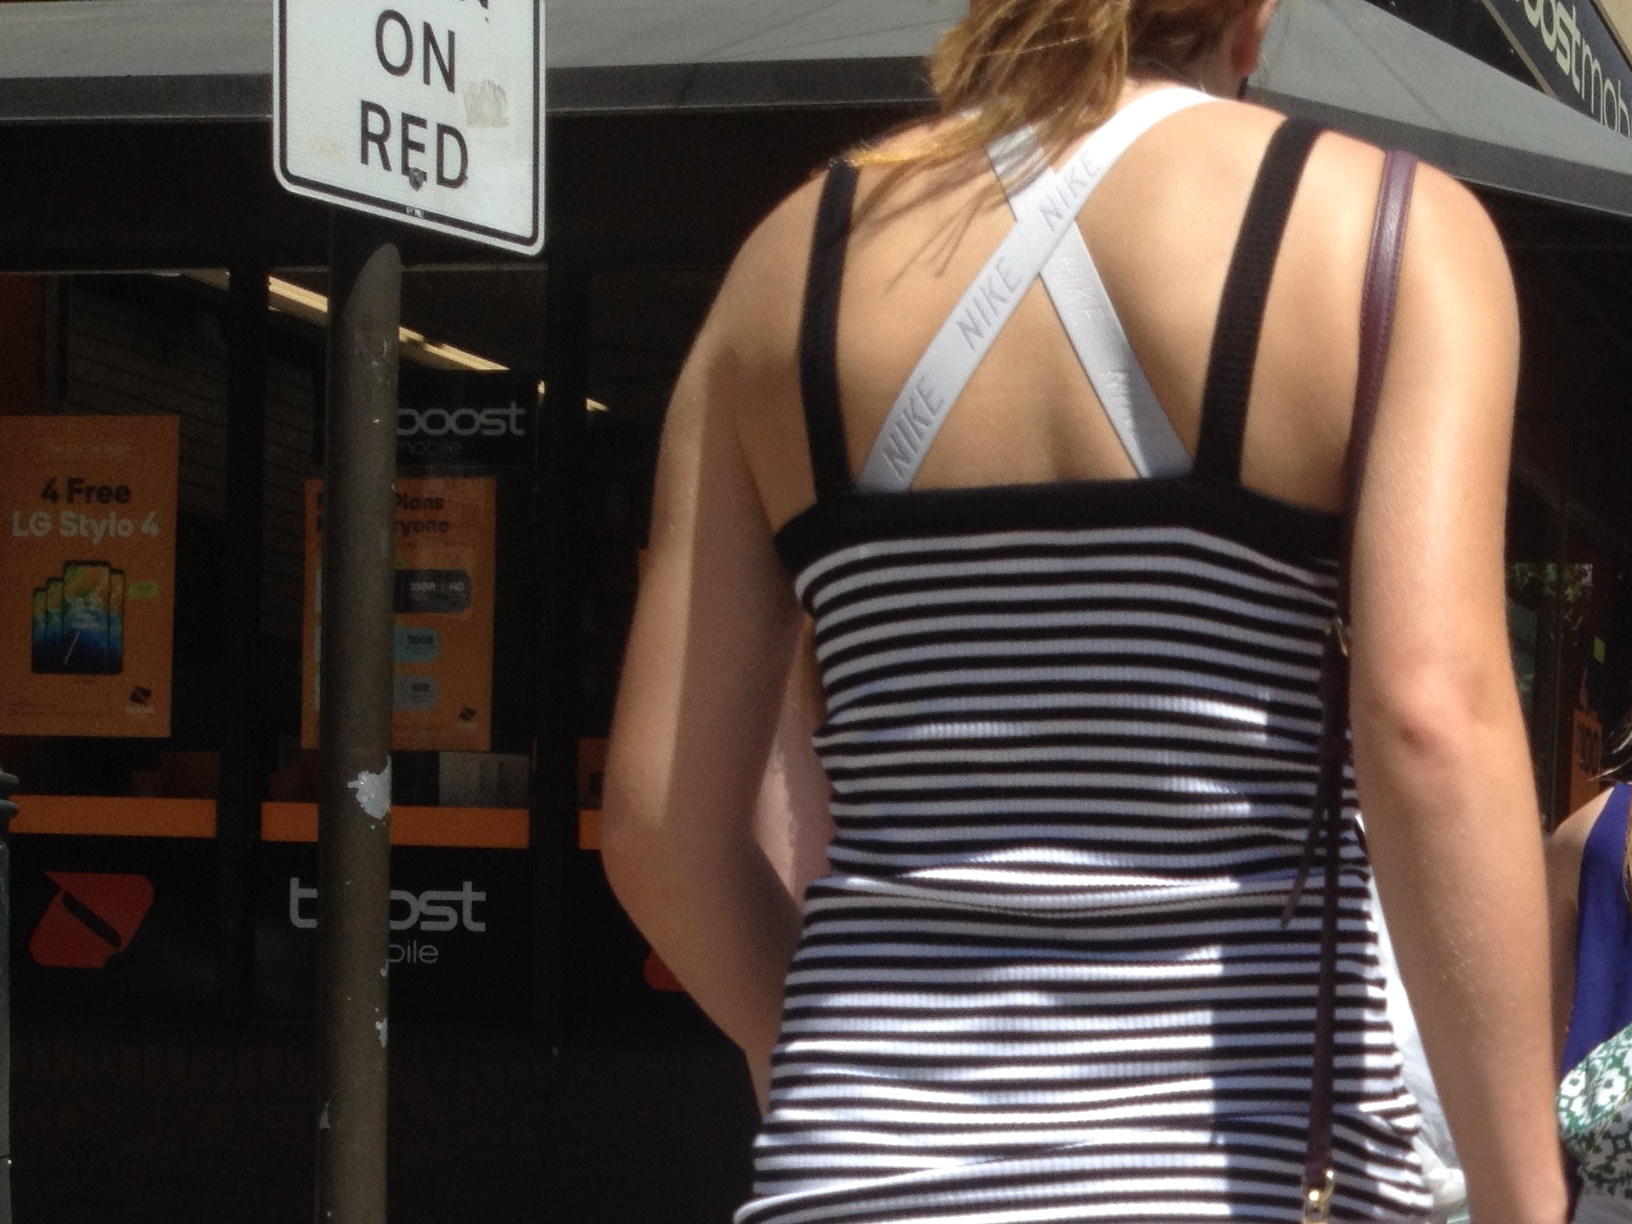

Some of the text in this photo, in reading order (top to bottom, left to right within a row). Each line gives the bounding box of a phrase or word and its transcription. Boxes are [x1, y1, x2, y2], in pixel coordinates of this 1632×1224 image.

[375, 9, 455, 94] ON
[360, 100, 469, 189] RED
[1038, 151, 1099, 232] NIKE
[956, 256, 1022, 352] NIKE
[880, 376, 945, 480] NIKE
[12, 510, 160, 545] LG Stylo 4
[41, 477, 132, 504] 4 Free
